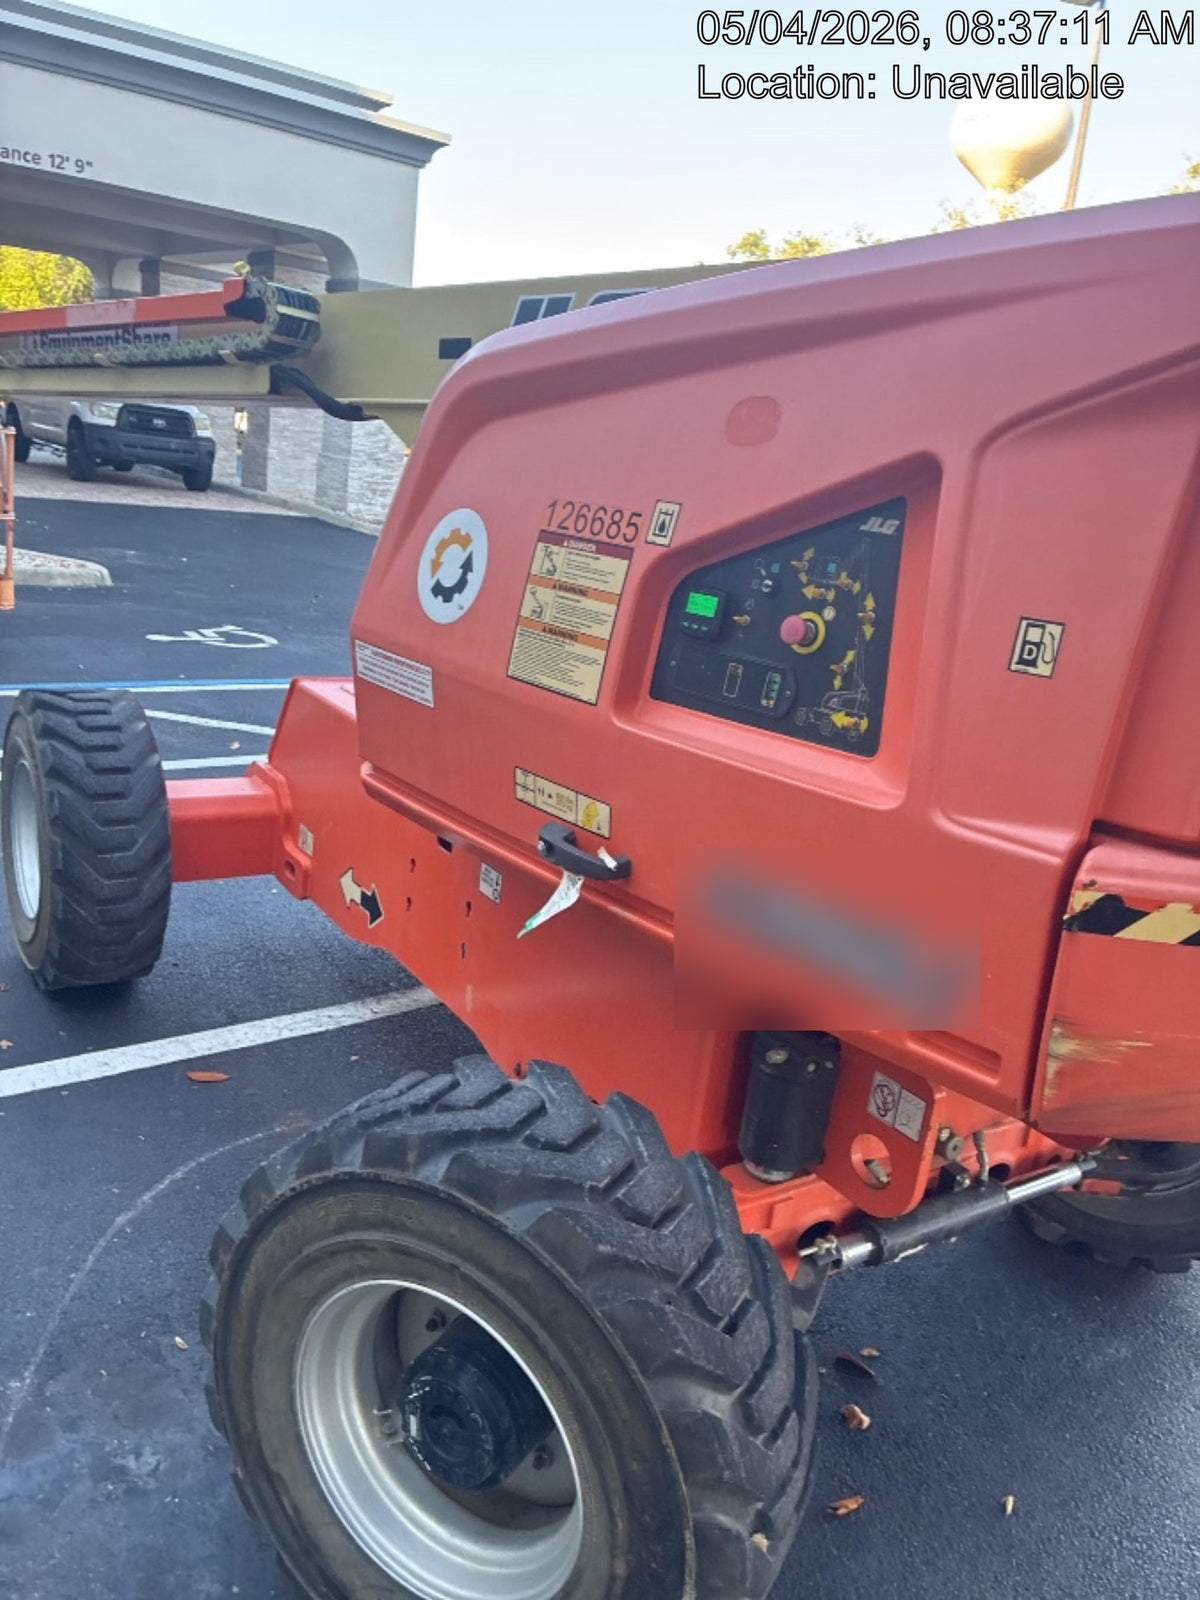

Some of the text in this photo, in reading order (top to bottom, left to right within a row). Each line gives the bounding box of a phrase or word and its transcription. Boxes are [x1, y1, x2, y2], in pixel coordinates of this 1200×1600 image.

[547, 500, 642, 543] 126685
[859, 516, 900, 535] JLG
[1022, 644, 1038, 660] D
